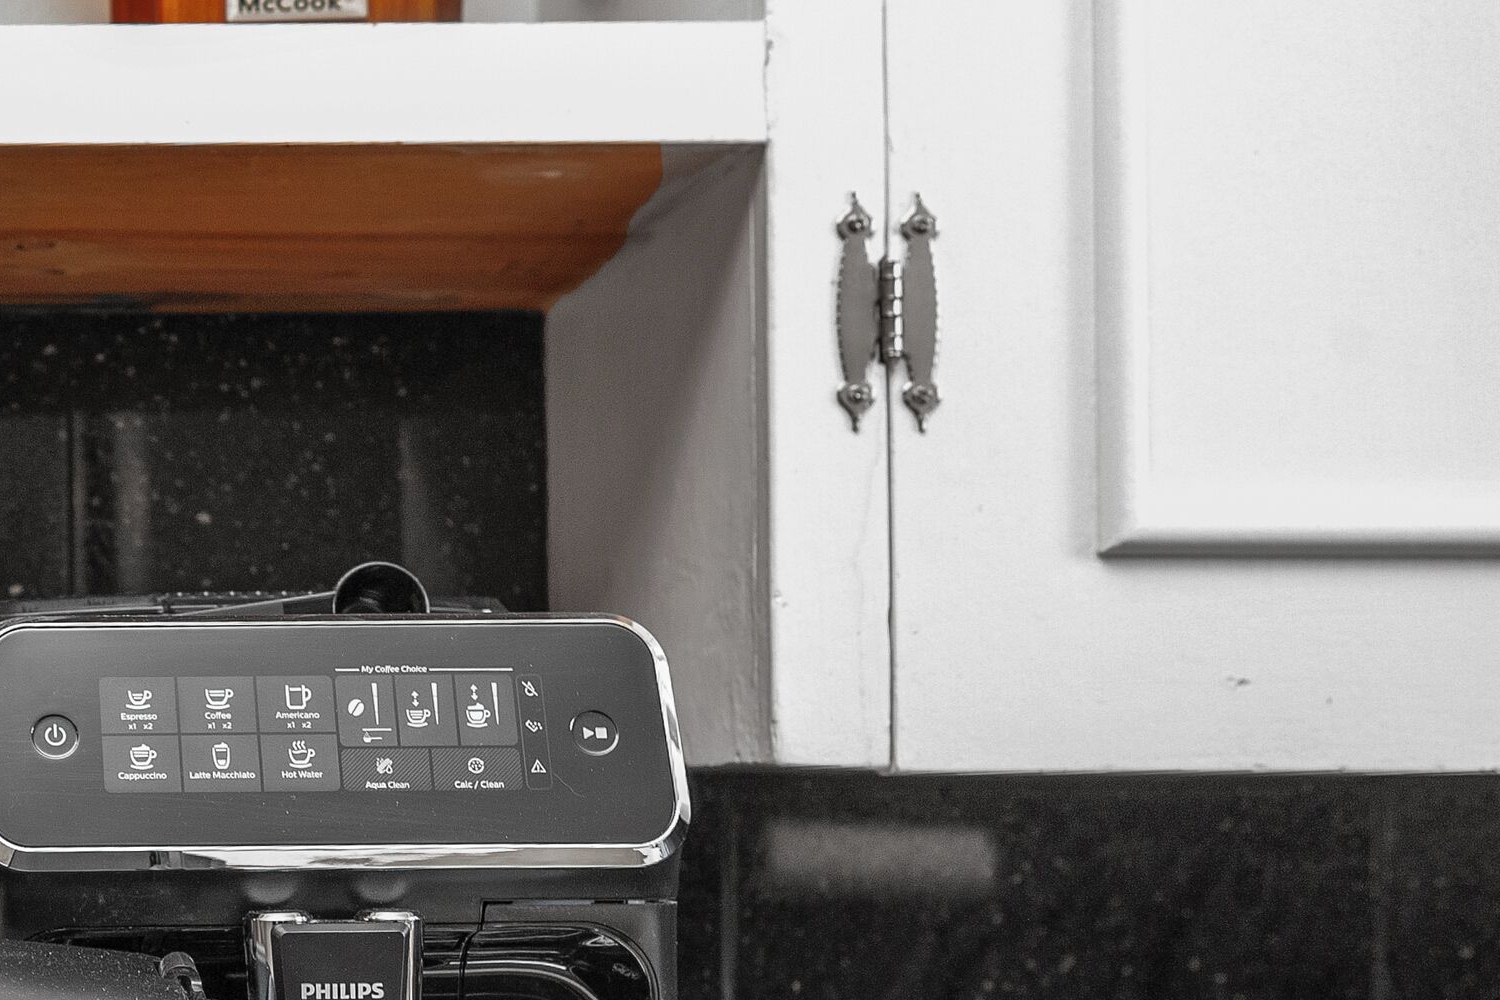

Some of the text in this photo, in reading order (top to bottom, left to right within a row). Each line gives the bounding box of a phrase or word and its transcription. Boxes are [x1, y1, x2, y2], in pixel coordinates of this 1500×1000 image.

[361, 664, 427, 674] My Coffee Choice
[120, 712, 158, 721] Espresso
[204, 711, 232, 720] Coffee
[275, 711, 320, 719] Americano
[207, 722, 233, 730] x1 x2
[286, 721, 312, 729] x1 x2
[117, 771, 167, 781] Cappuccino
[189, 770, 256, 779] Latte Macchiato
[281, 770, 323, 779] Hot Water
[365, 780, 410, 790] Aqua Clean
[454, 780, 473, 789] Calc
[480, 780, 505, 789] Clean
[300, 982, 385, 1000] PHILIPS
